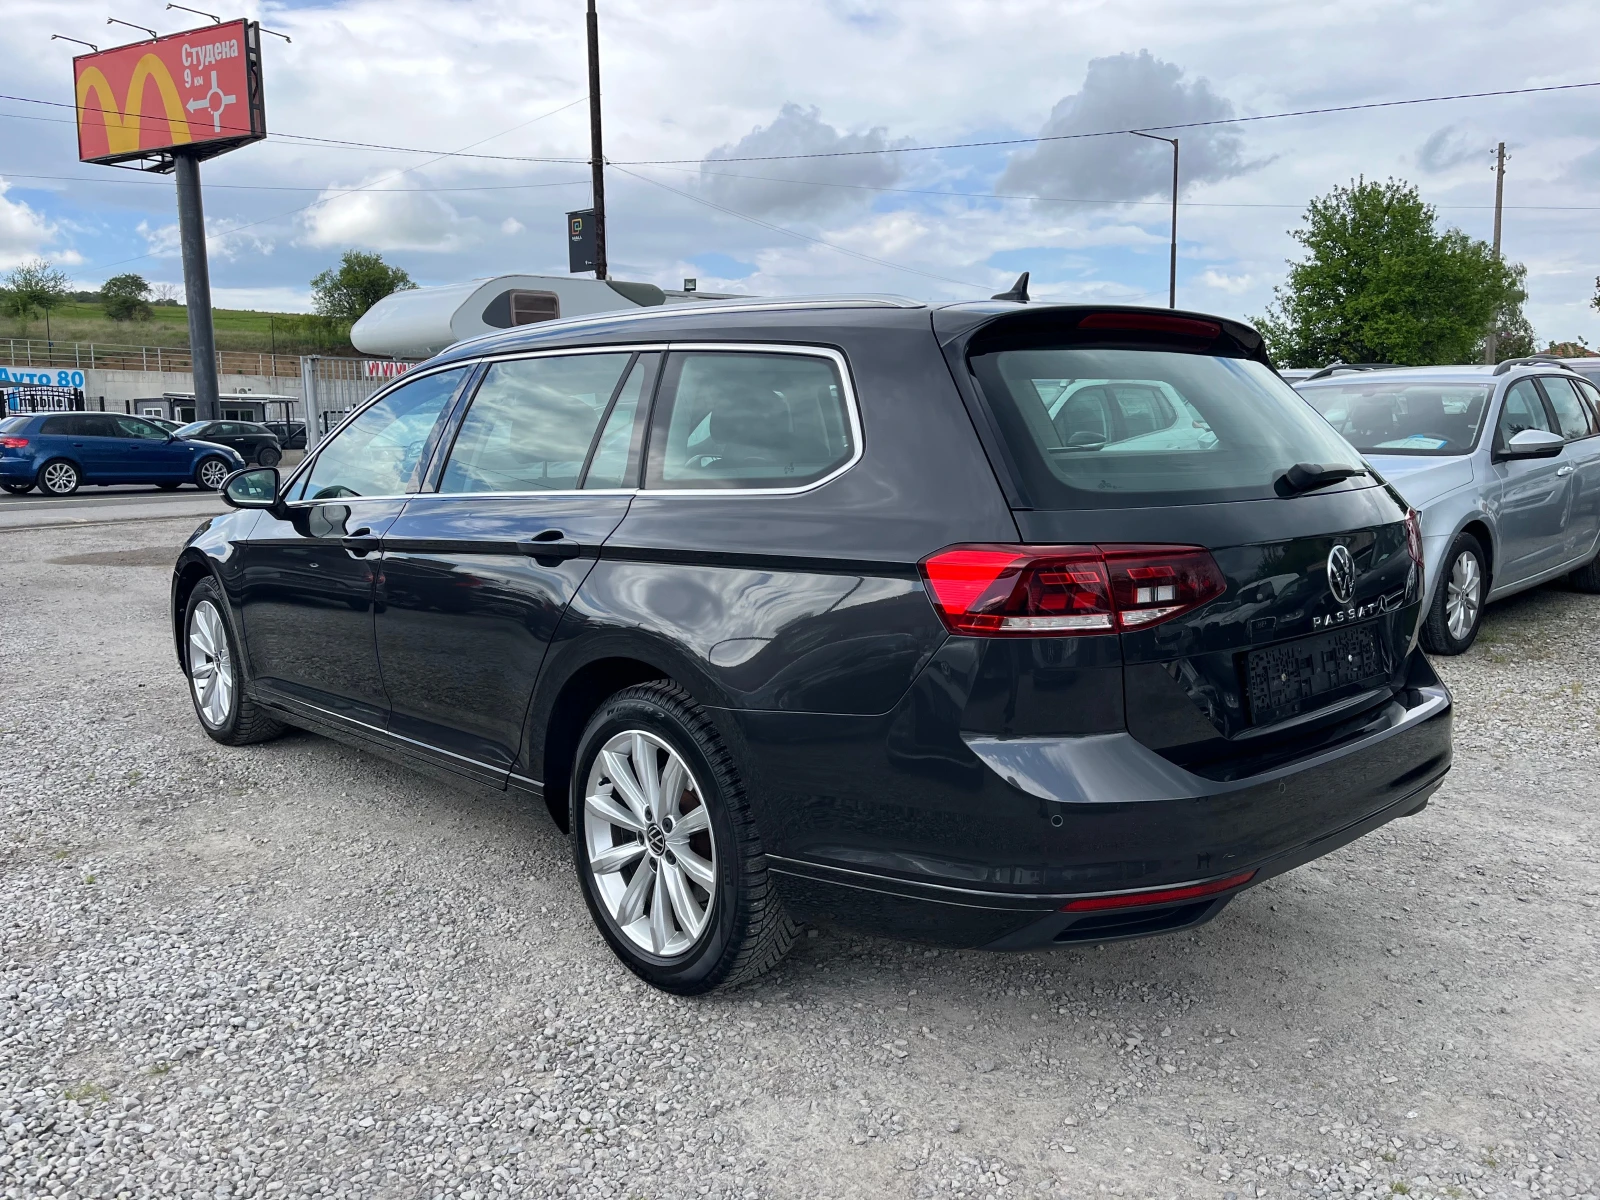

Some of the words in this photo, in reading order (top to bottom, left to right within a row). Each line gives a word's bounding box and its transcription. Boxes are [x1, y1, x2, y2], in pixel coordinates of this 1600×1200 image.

[182, 39, 239, 70] Студена
[184, 69, 192, 88] 9
[194, 76, 203, 86] км
[57, 371, 84, 388] 80
[1313, 603, 1374, 628] PASSAT
